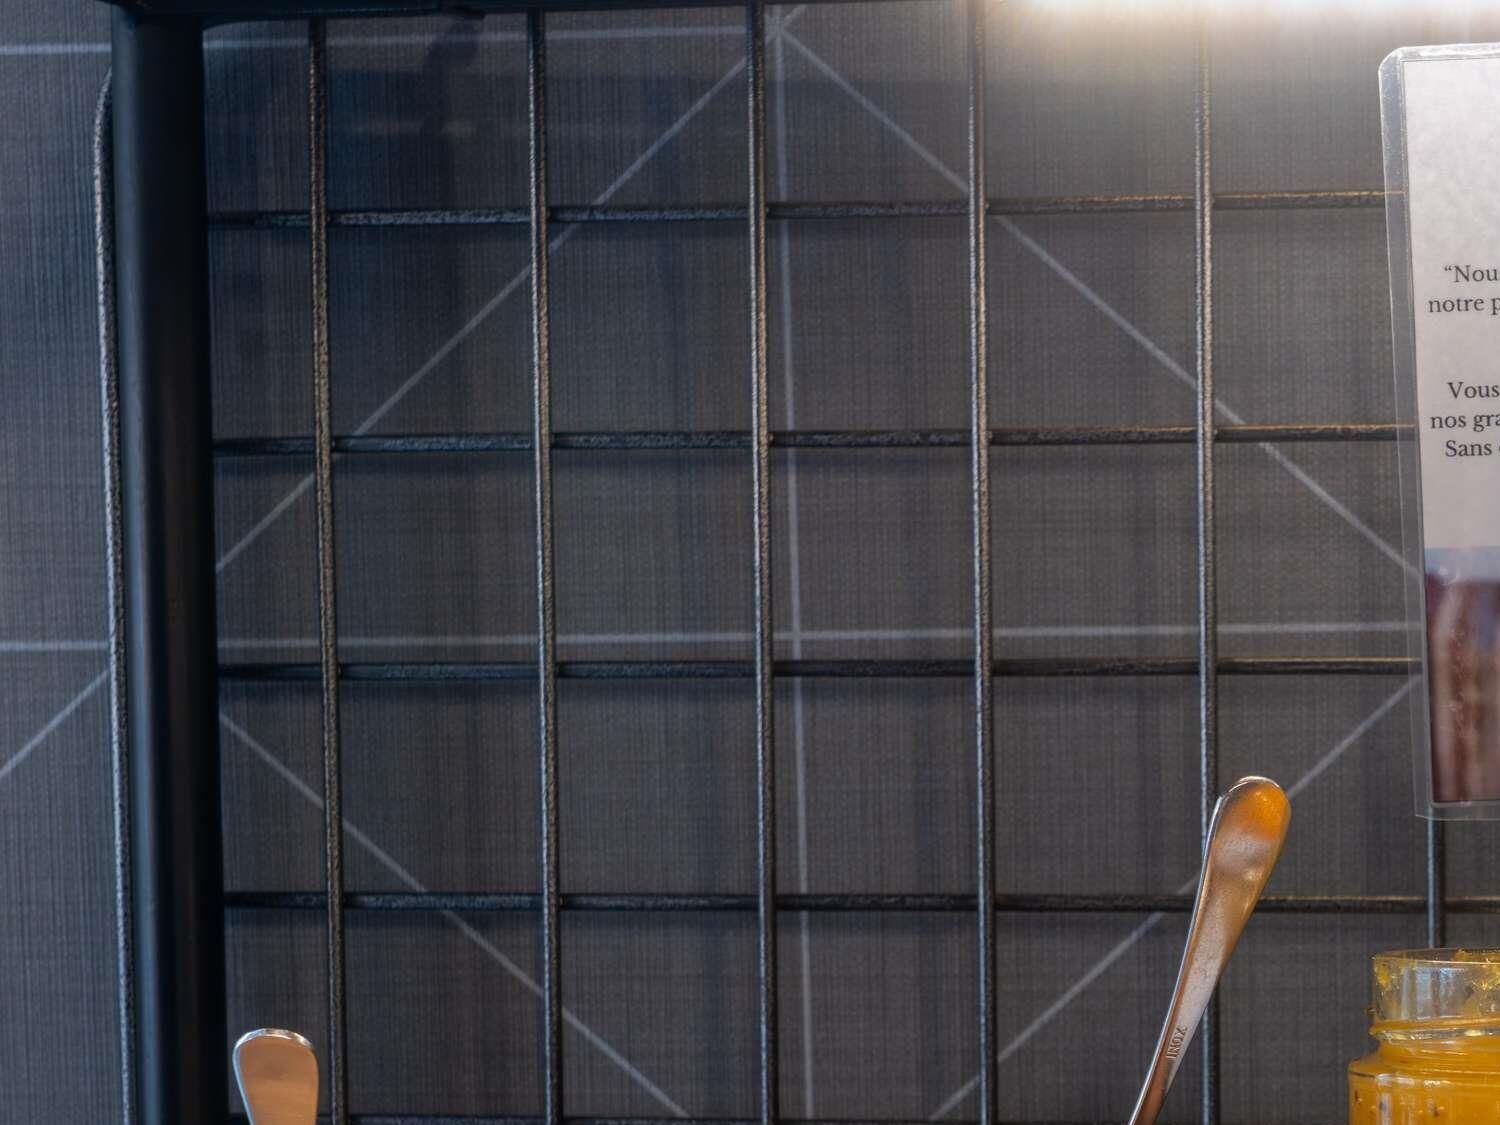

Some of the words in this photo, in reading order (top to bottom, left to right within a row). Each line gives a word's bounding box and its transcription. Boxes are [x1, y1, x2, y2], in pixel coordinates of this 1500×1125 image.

[1427, 297, 1485, 314] notre
[1446, 381, 1500, 400] Vous
[1429, 415, 1467, 430] nos
[1444, 439, 1493, 458] Sans
